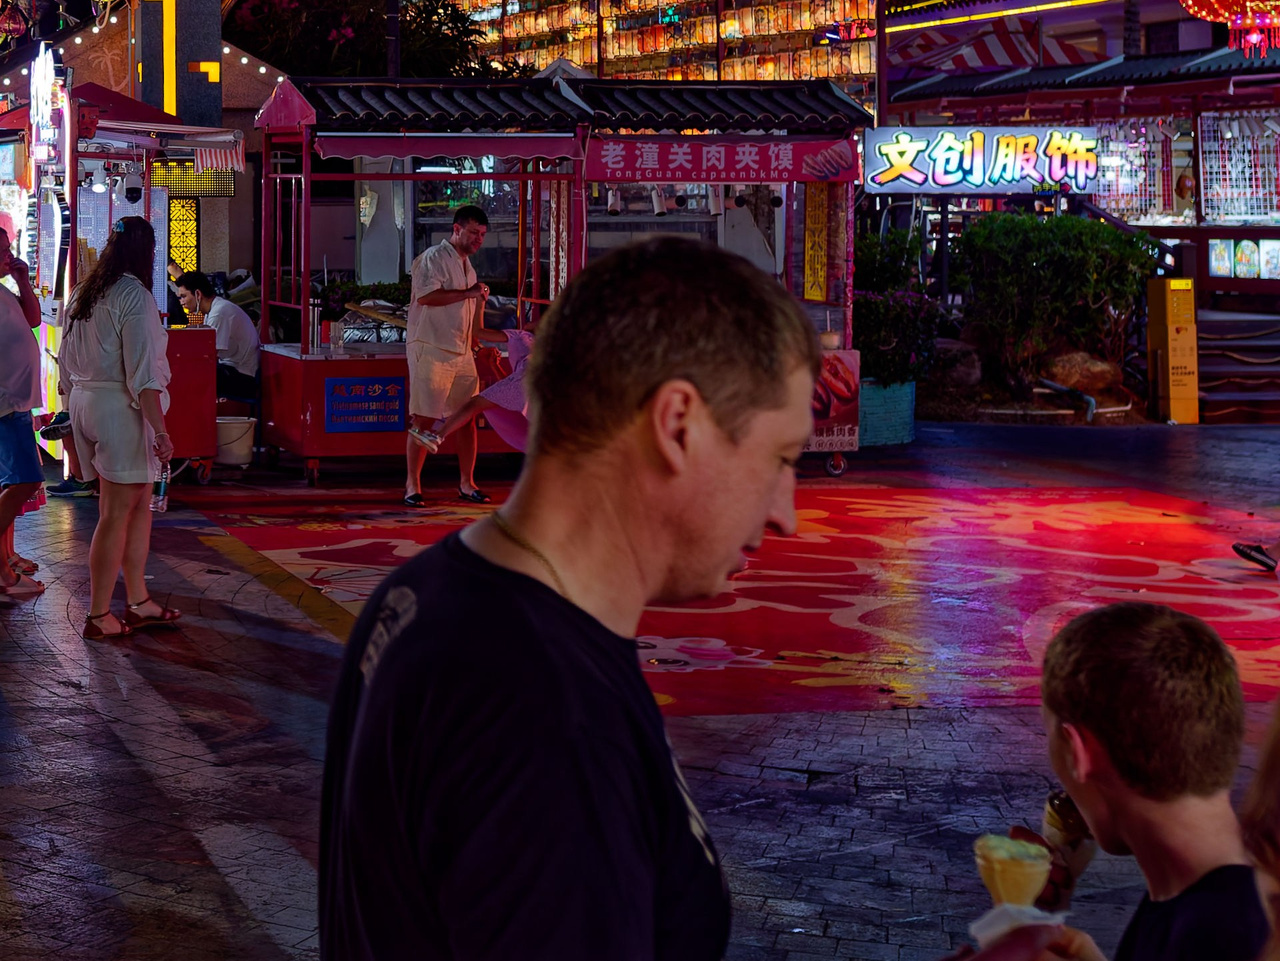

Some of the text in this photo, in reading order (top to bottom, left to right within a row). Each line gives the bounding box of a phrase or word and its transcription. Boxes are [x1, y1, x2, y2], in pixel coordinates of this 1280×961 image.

[600, 142, 794, 171] 老潼关肉夹馍
[867, 130, 1098, 192] 文创服饰
[606, 169, 682, 180] TongGuan
